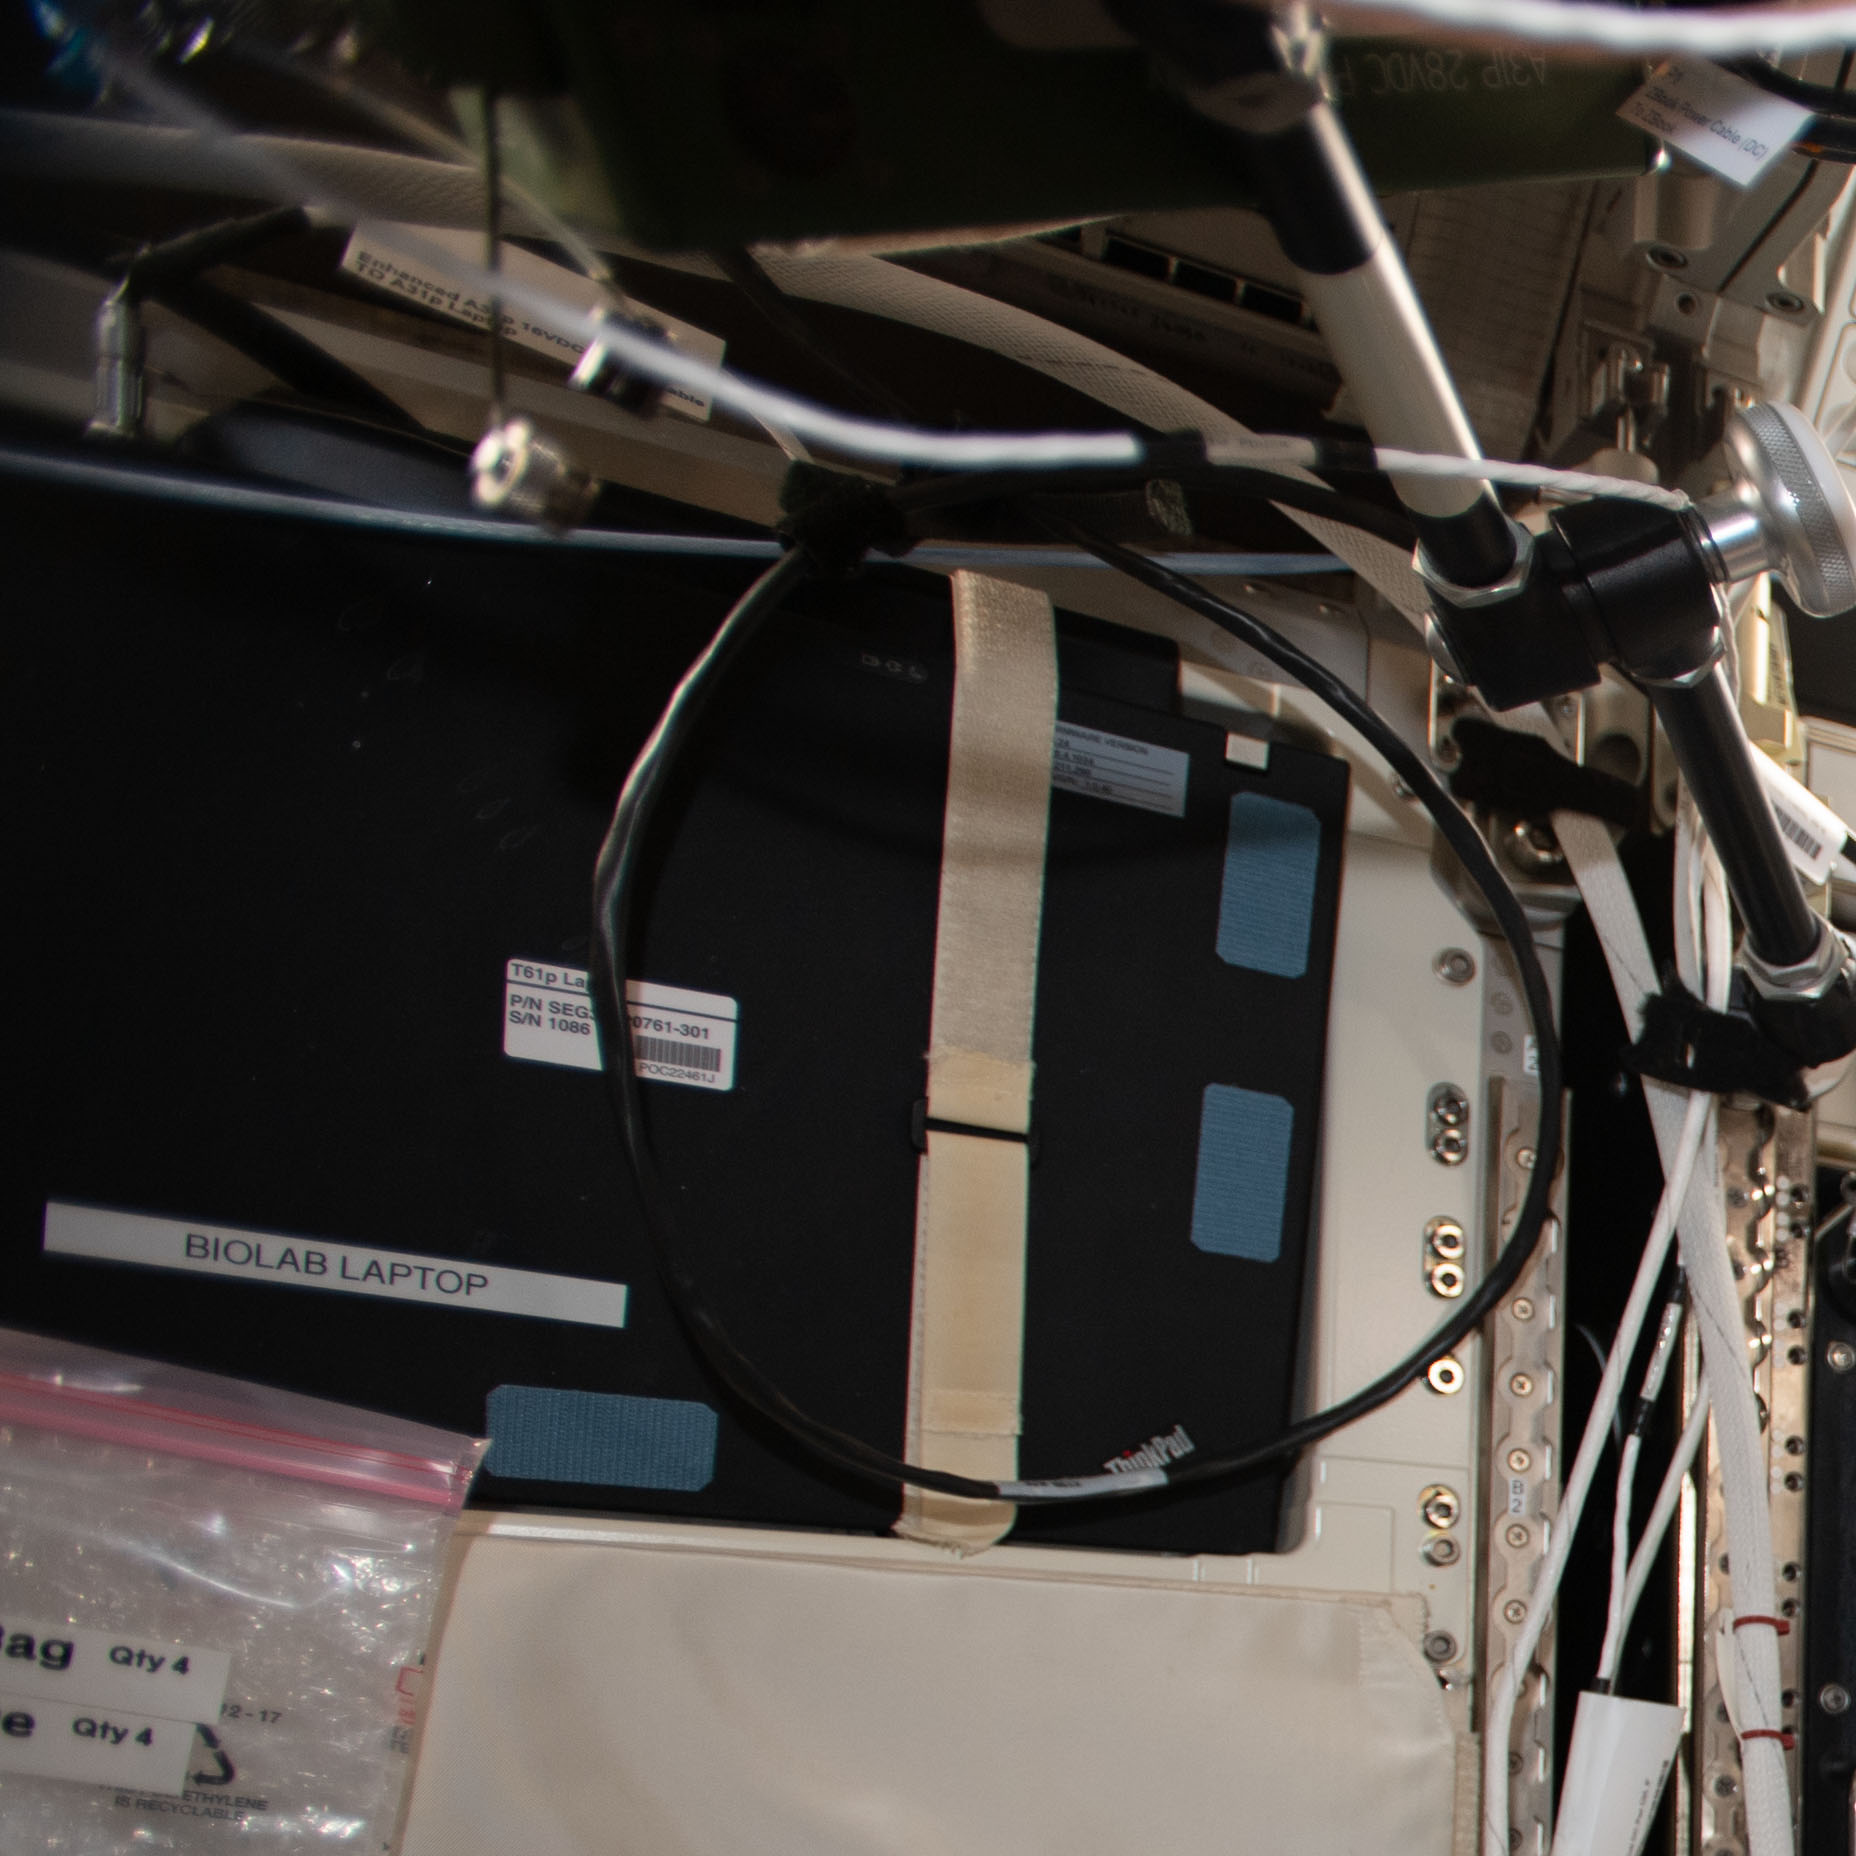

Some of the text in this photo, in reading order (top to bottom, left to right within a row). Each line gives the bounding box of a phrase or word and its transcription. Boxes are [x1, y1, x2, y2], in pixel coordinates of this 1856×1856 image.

[1710, 119, 1741, 144] Cable
[1740, 137, 1768, 161] (DC)
[356, 263, 517, 338] TO A31p Lapp
[357, 251, 704, 408] Enhanced A3p 16VDC able
[511, 963, 585, 988] T61p La
[509, 994, 543, 1012] P/N
[508, 1010, 591, 1036] S/N 1086
[184, 1232, 490, 1299] BIOLAB LAPTOP
[0, 1626, 190, 1675] ag Qty 4
[0, 1711, 153, 1746] e Qty 4
[135, 1798, 246, 1821] RECYCLABLE
[181, 1789, 268, 1811] ETHYLENE
